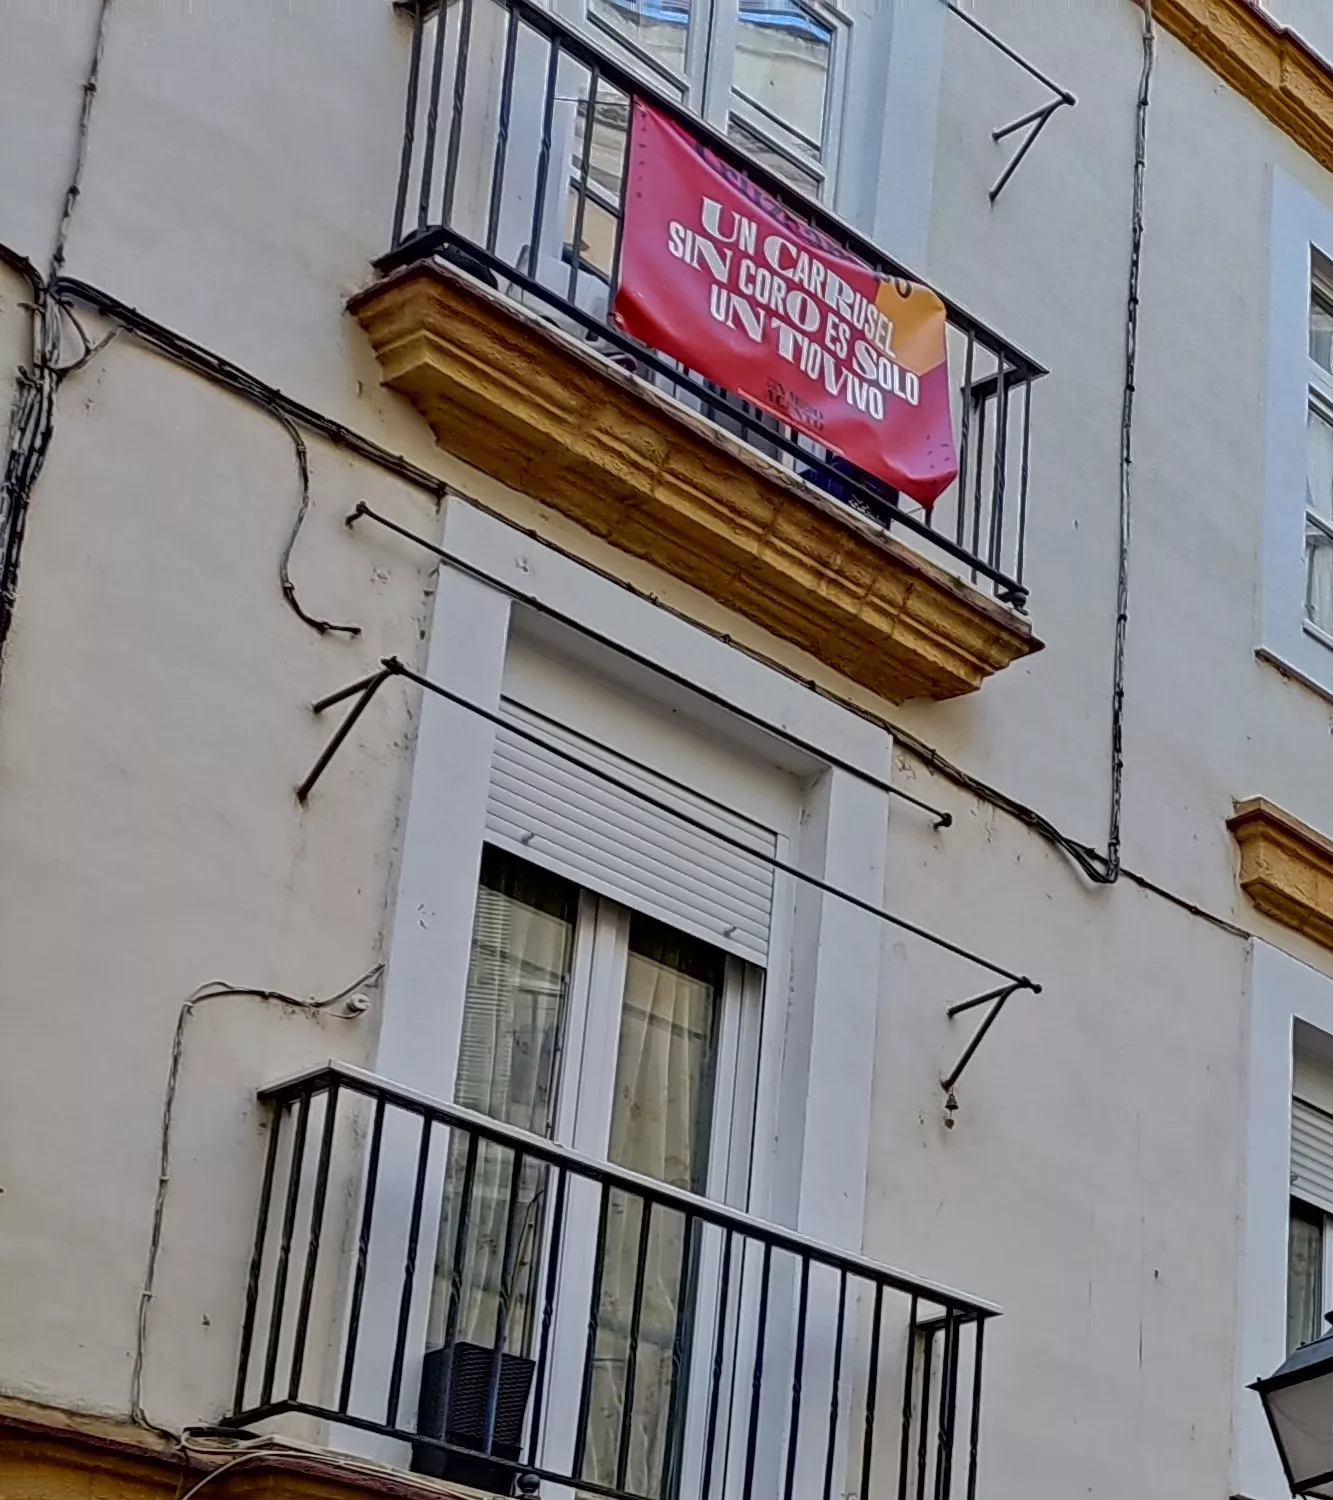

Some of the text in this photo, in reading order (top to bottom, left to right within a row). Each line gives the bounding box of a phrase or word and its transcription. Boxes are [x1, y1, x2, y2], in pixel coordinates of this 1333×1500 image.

[668, 221, 733, 284] SIN
[739, 259, 821, 332] CORO
[825, 313, 850, 359] ES
[852, 340, 919, 406] SOLO
[701, 196, 757, 256] UN
[764, 235, 896, 358] CARRUSEL
[710, 284, 766, 342] UN
